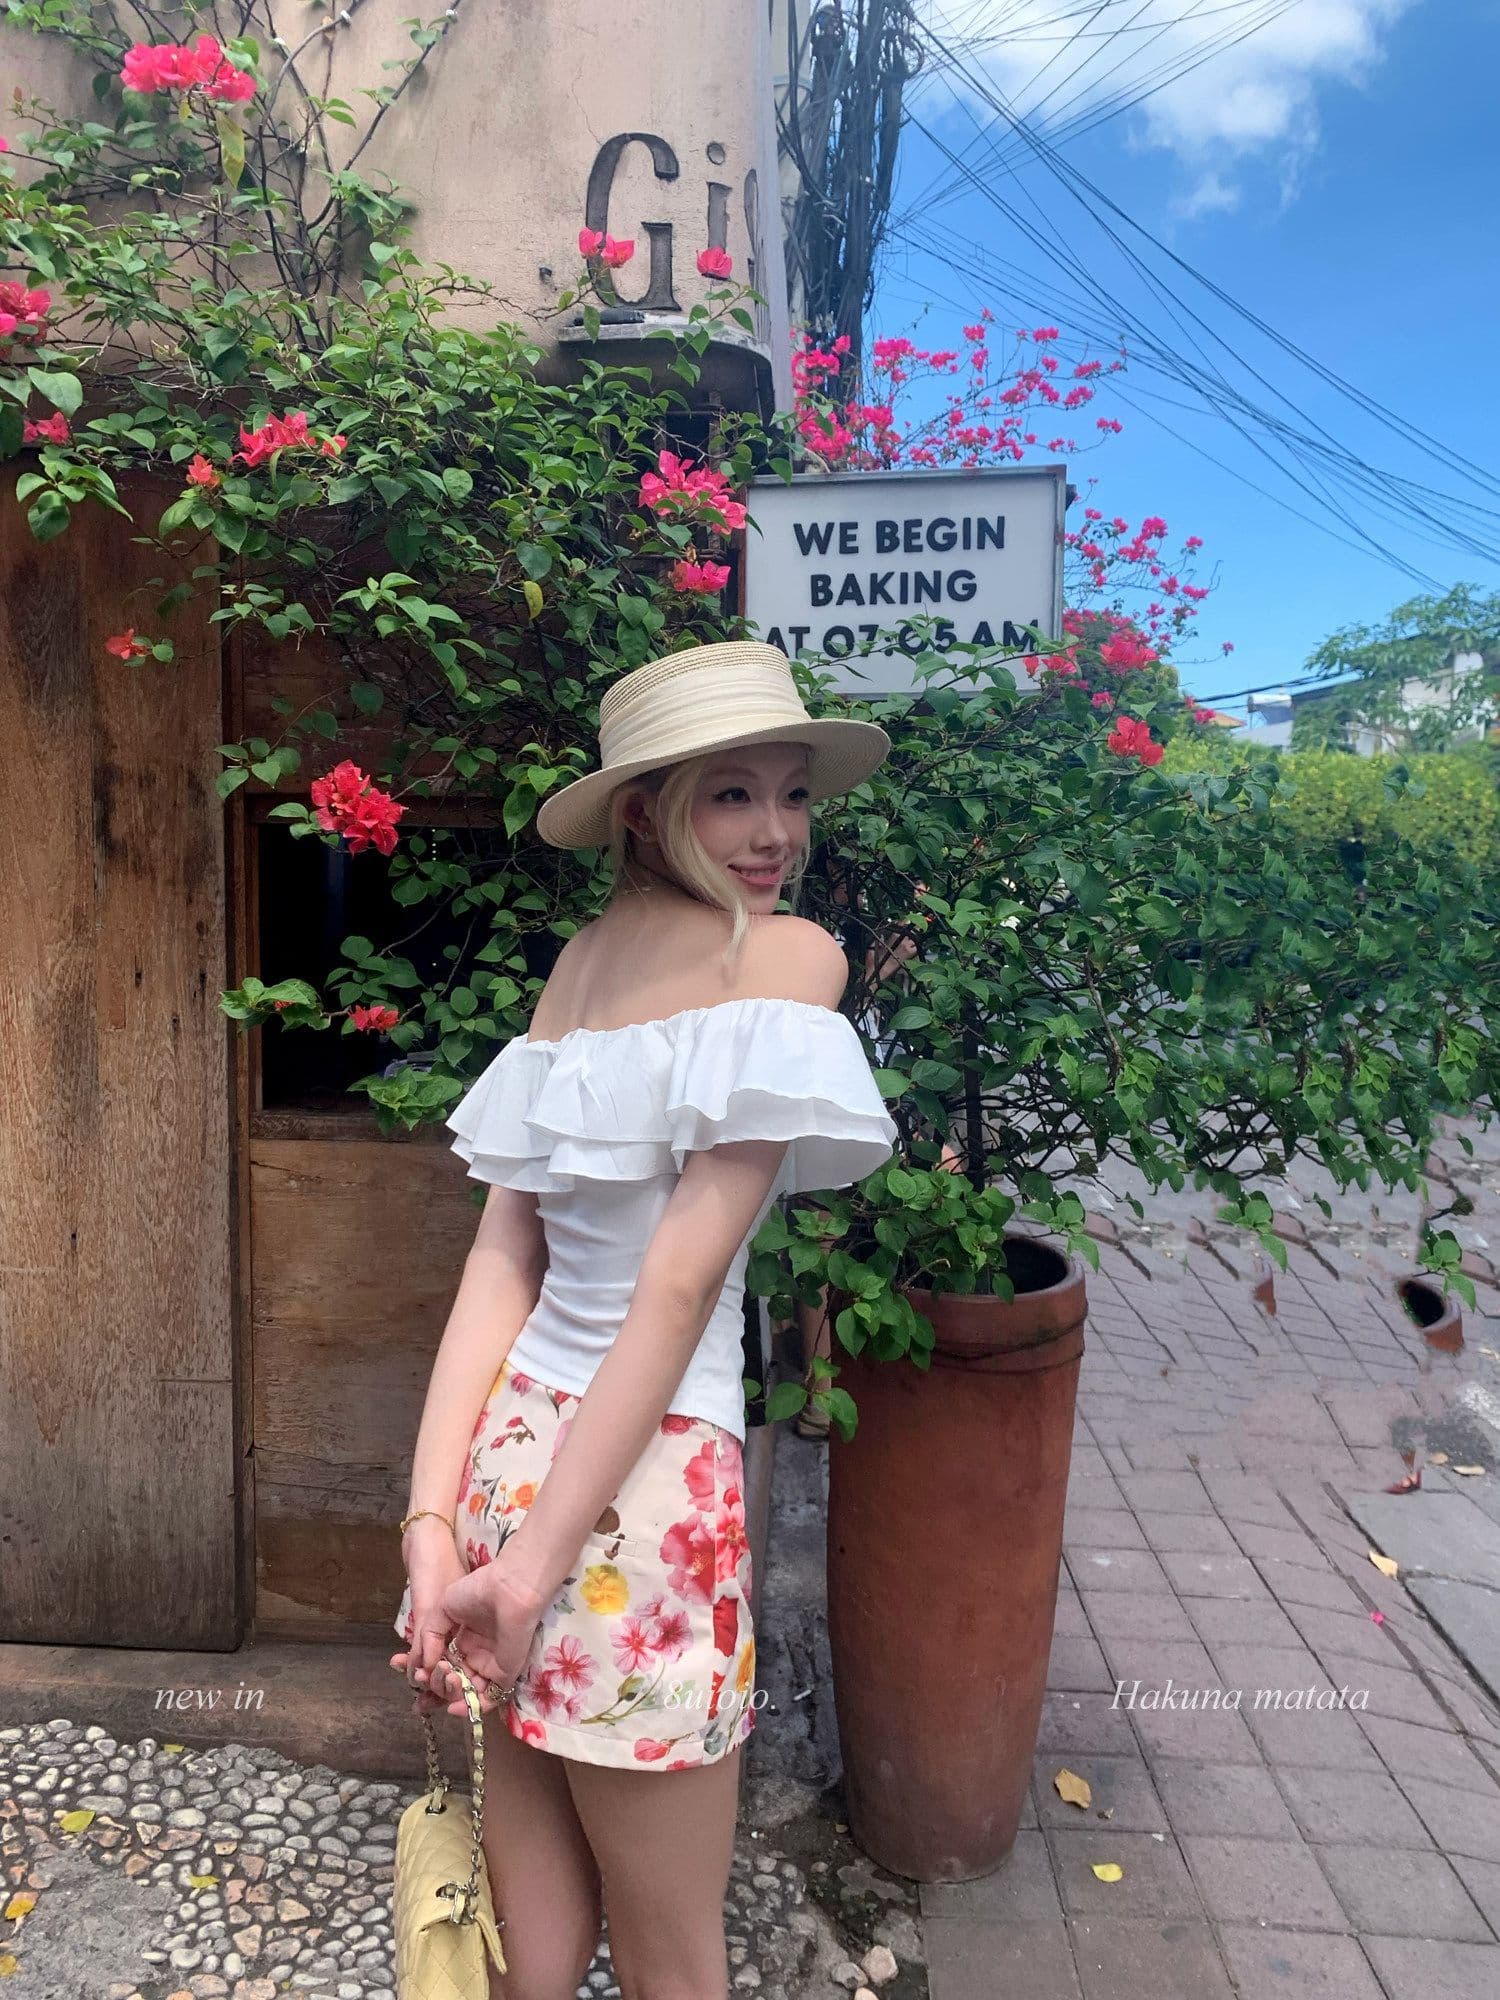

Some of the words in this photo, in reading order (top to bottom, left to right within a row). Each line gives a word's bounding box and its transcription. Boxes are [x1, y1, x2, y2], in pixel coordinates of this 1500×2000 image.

[793, 521, 859, 556] WE
[875, 515, 1005, 554] BEGIN
[810, 568, 978, 607] BAKING
[766, 626, 811, 659] AT
[971, 619, 1039, 653] AM
